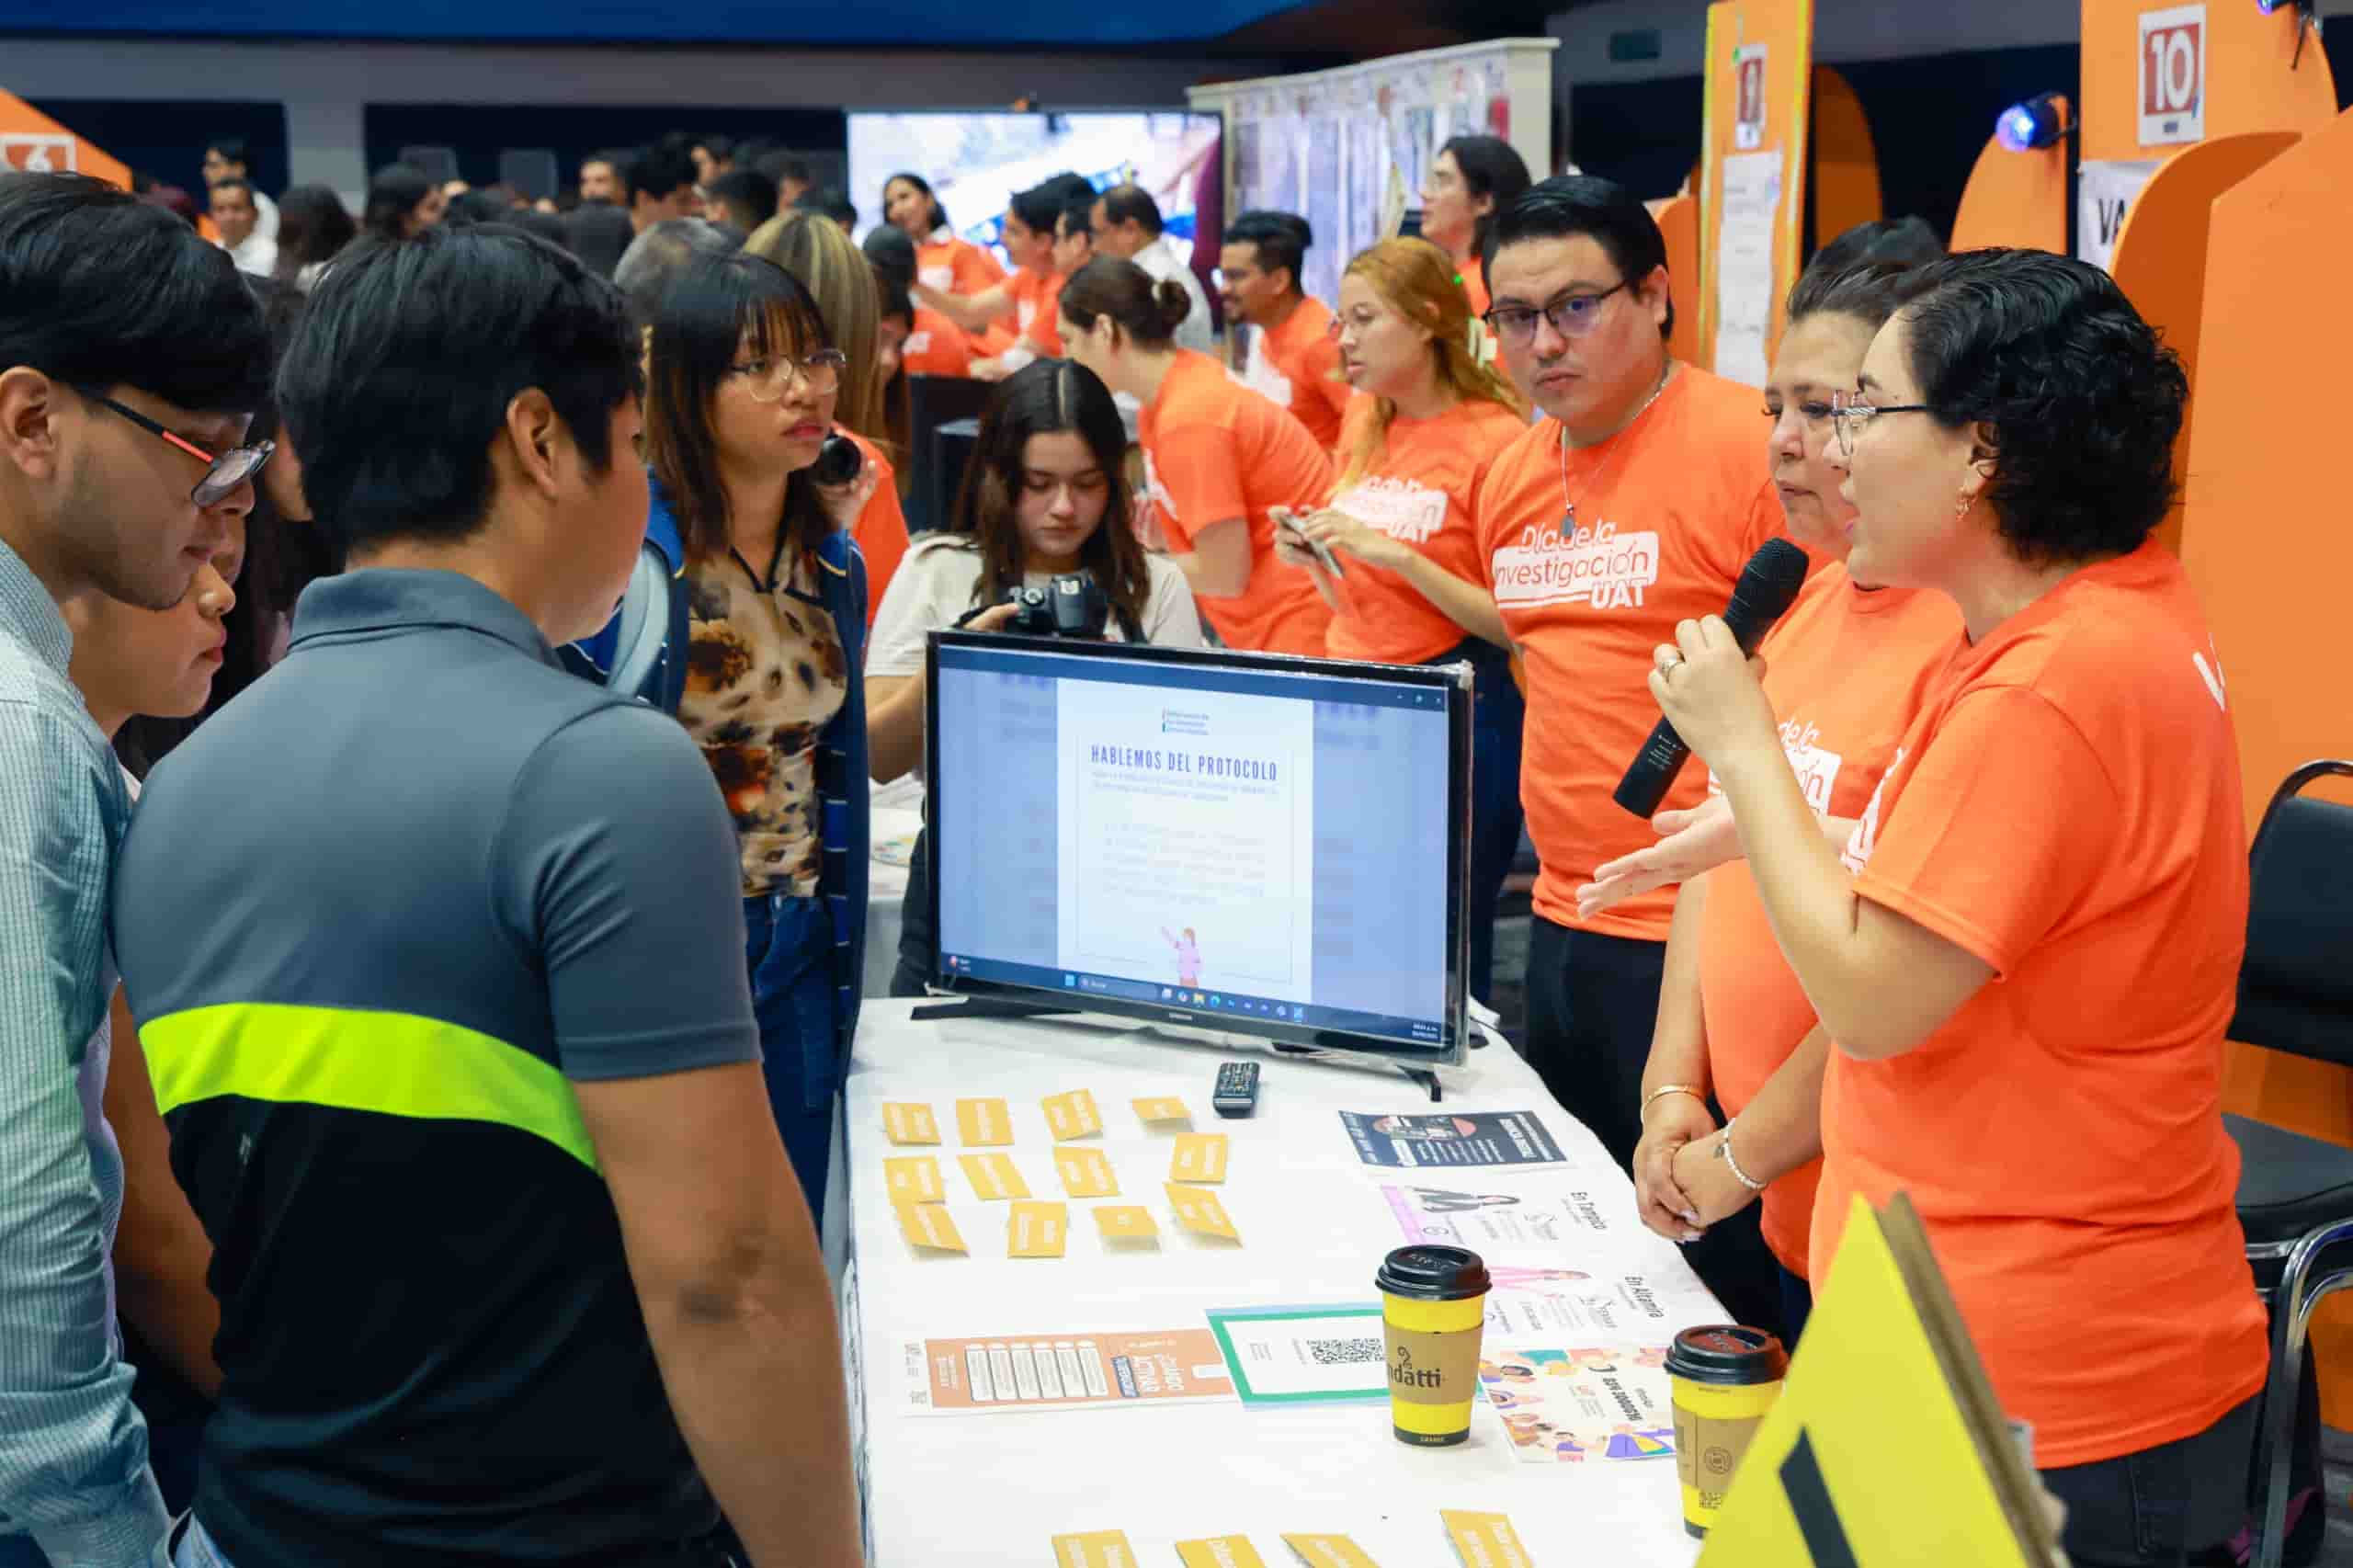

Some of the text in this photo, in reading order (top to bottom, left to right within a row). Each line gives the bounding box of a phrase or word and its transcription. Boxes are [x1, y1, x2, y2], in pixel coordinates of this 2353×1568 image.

[2151, 28, 2195, 112] 10
[1521, 522, 1559, 553] Día
[1495, 540, 1649, 588] nvestigación
[1590, 579, 1648, 609] UAT
[1091, 744, 1278, 781] HABLEMOS DEL PROTOCOLO
[1388, 1363, 1442, 1389] ndatti
